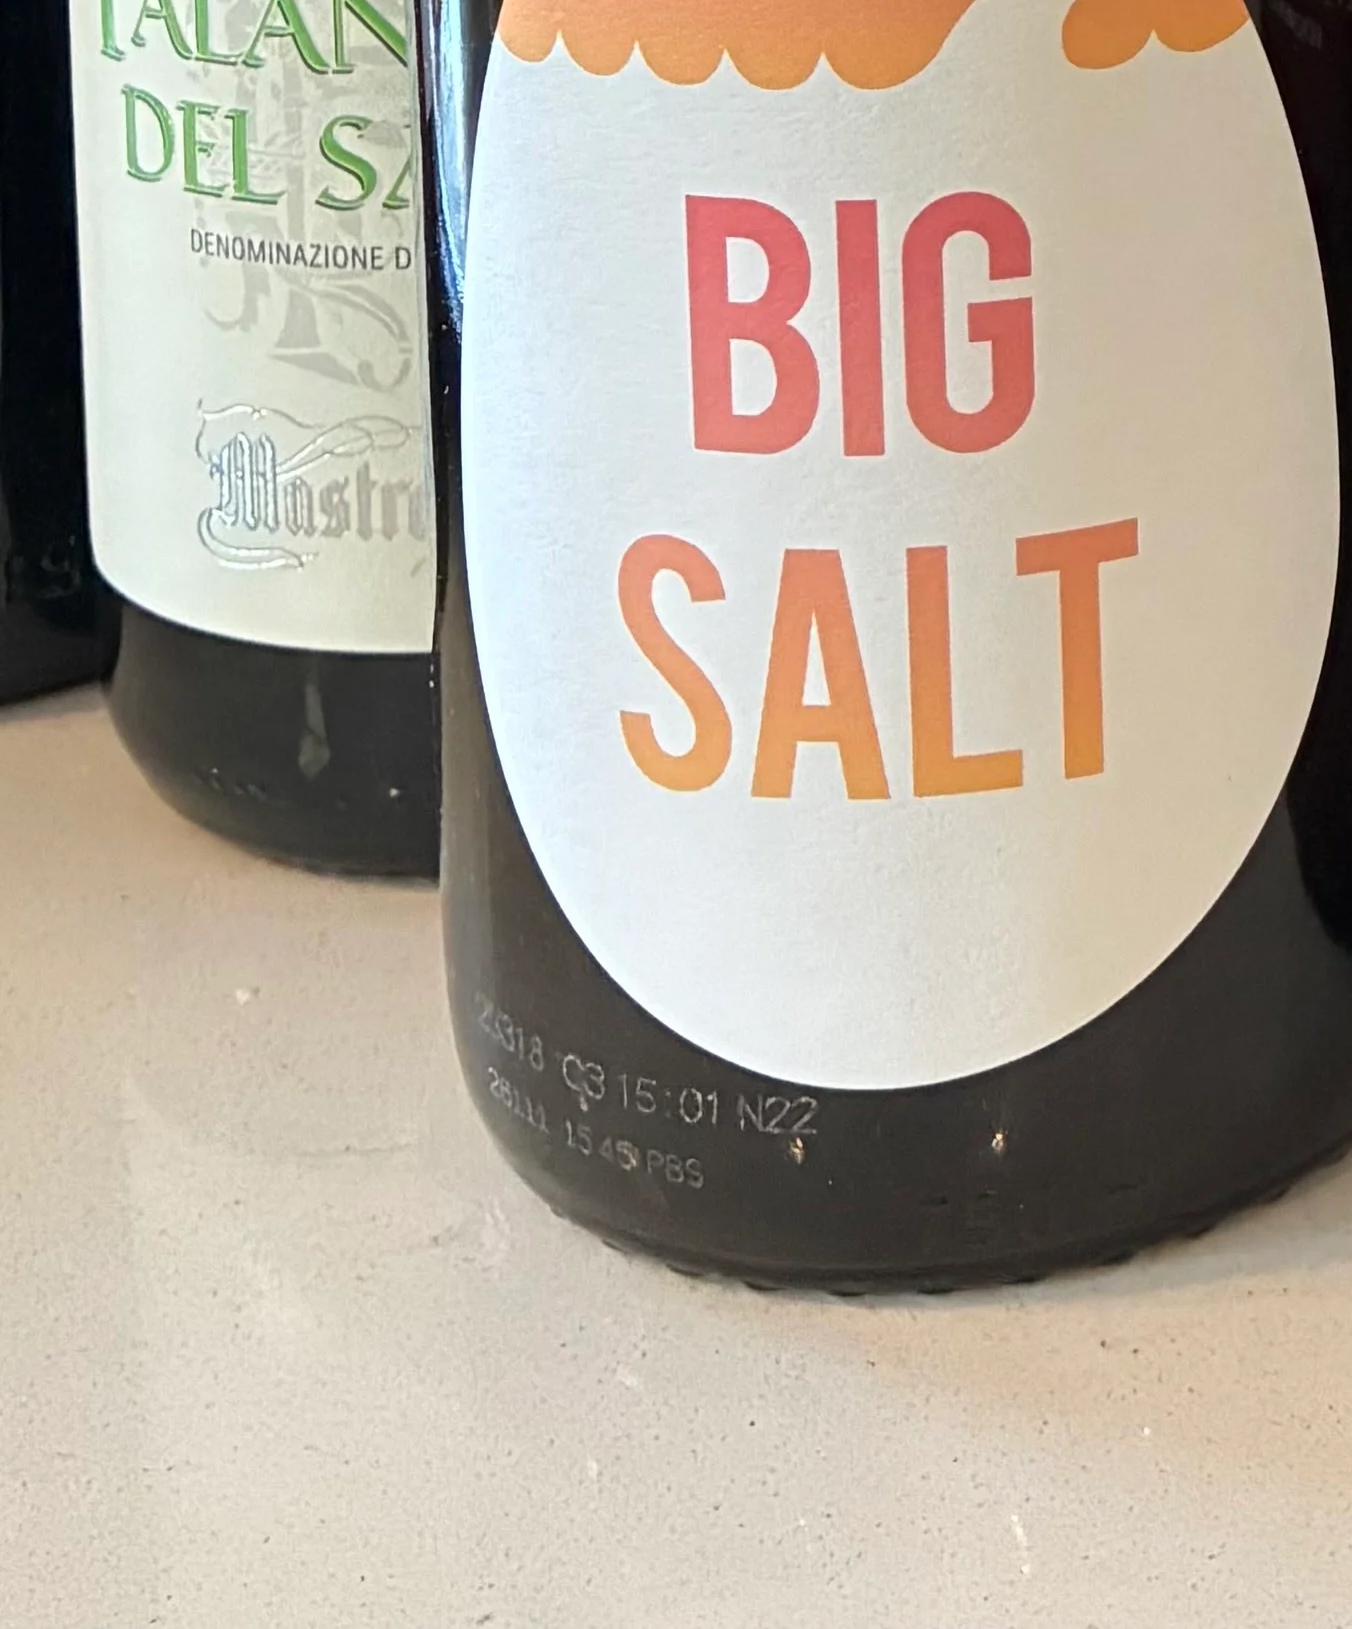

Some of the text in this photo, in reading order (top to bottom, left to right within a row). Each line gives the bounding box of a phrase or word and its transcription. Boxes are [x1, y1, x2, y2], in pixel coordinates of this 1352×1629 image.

[121, 83, 286, 205] DEL
[190, 228, 384, 271] DENOMINAZIONE
[685, 191, 1036, 457] BIG
[617, 517, 1139, 800] SALT
[737, 1095, 818, 1135] N22
